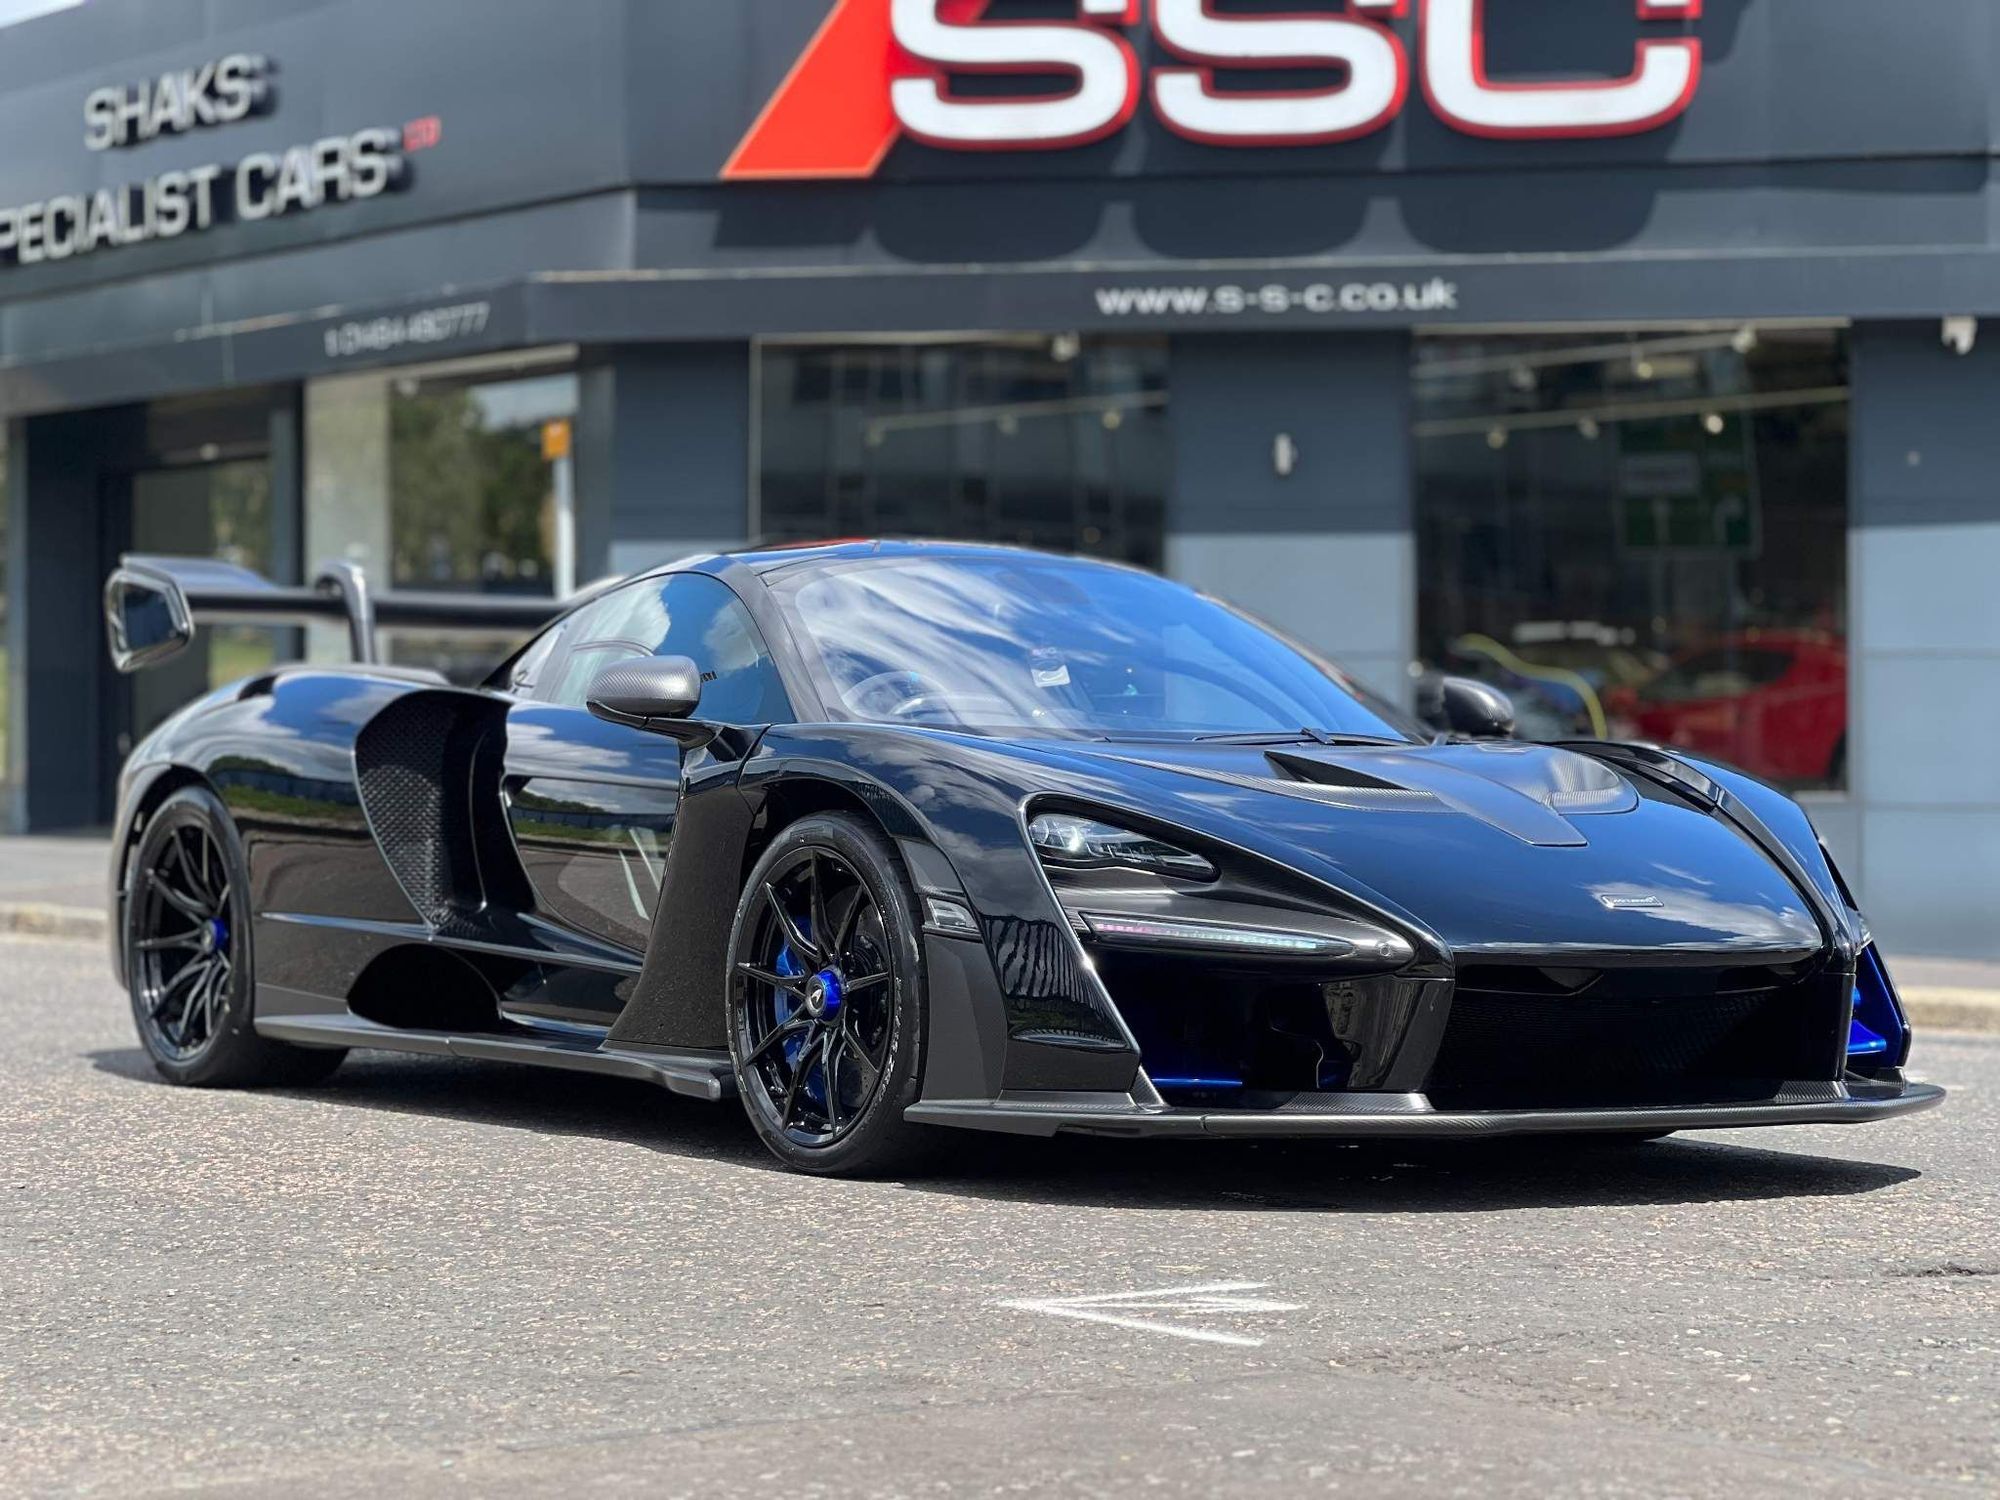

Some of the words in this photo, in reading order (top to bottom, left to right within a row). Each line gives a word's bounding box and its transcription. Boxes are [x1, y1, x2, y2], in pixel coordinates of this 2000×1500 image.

[84, 53, 266, 150] SHAKS
[889, 0, 1702, 150] SSC
[236, 127, 399, 220] CARS
[1095, 276, 1457, 316] www.s-s-c.co.uk
